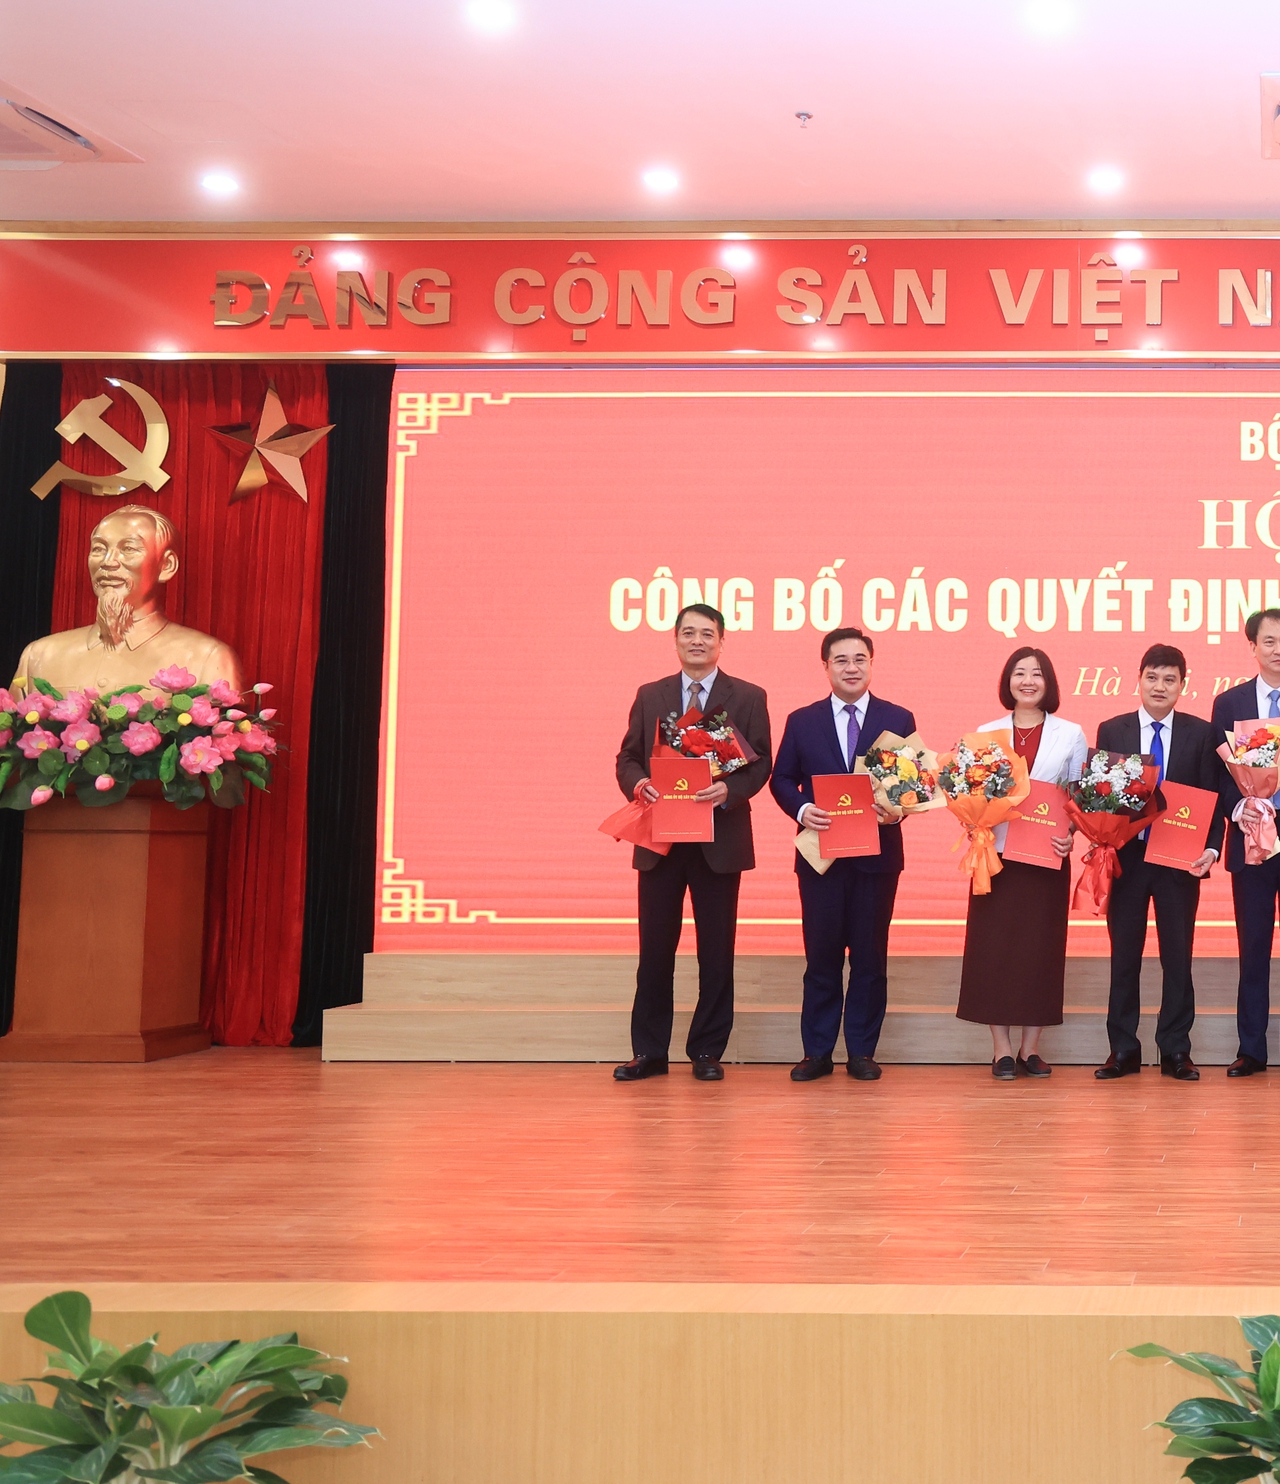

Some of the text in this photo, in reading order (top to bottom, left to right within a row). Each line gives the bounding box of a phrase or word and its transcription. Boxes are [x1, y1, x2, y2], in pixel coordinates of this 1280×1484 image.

[211, 245, 451, 326] ĐẢNG
[494, 252, 736, 340] CỘNG
[776, 244, 947, 326] SẢN
[989, 253, 1179, 340] VIỆT
[609, 566, 754, 632] CÔNG
[773, 558, 844, 632] BỐ
[861, 566, 969, 632] CÁC
[987, 560, 1154, 639] QUYẾT
[1072, 667, 1121, 696] Hà
